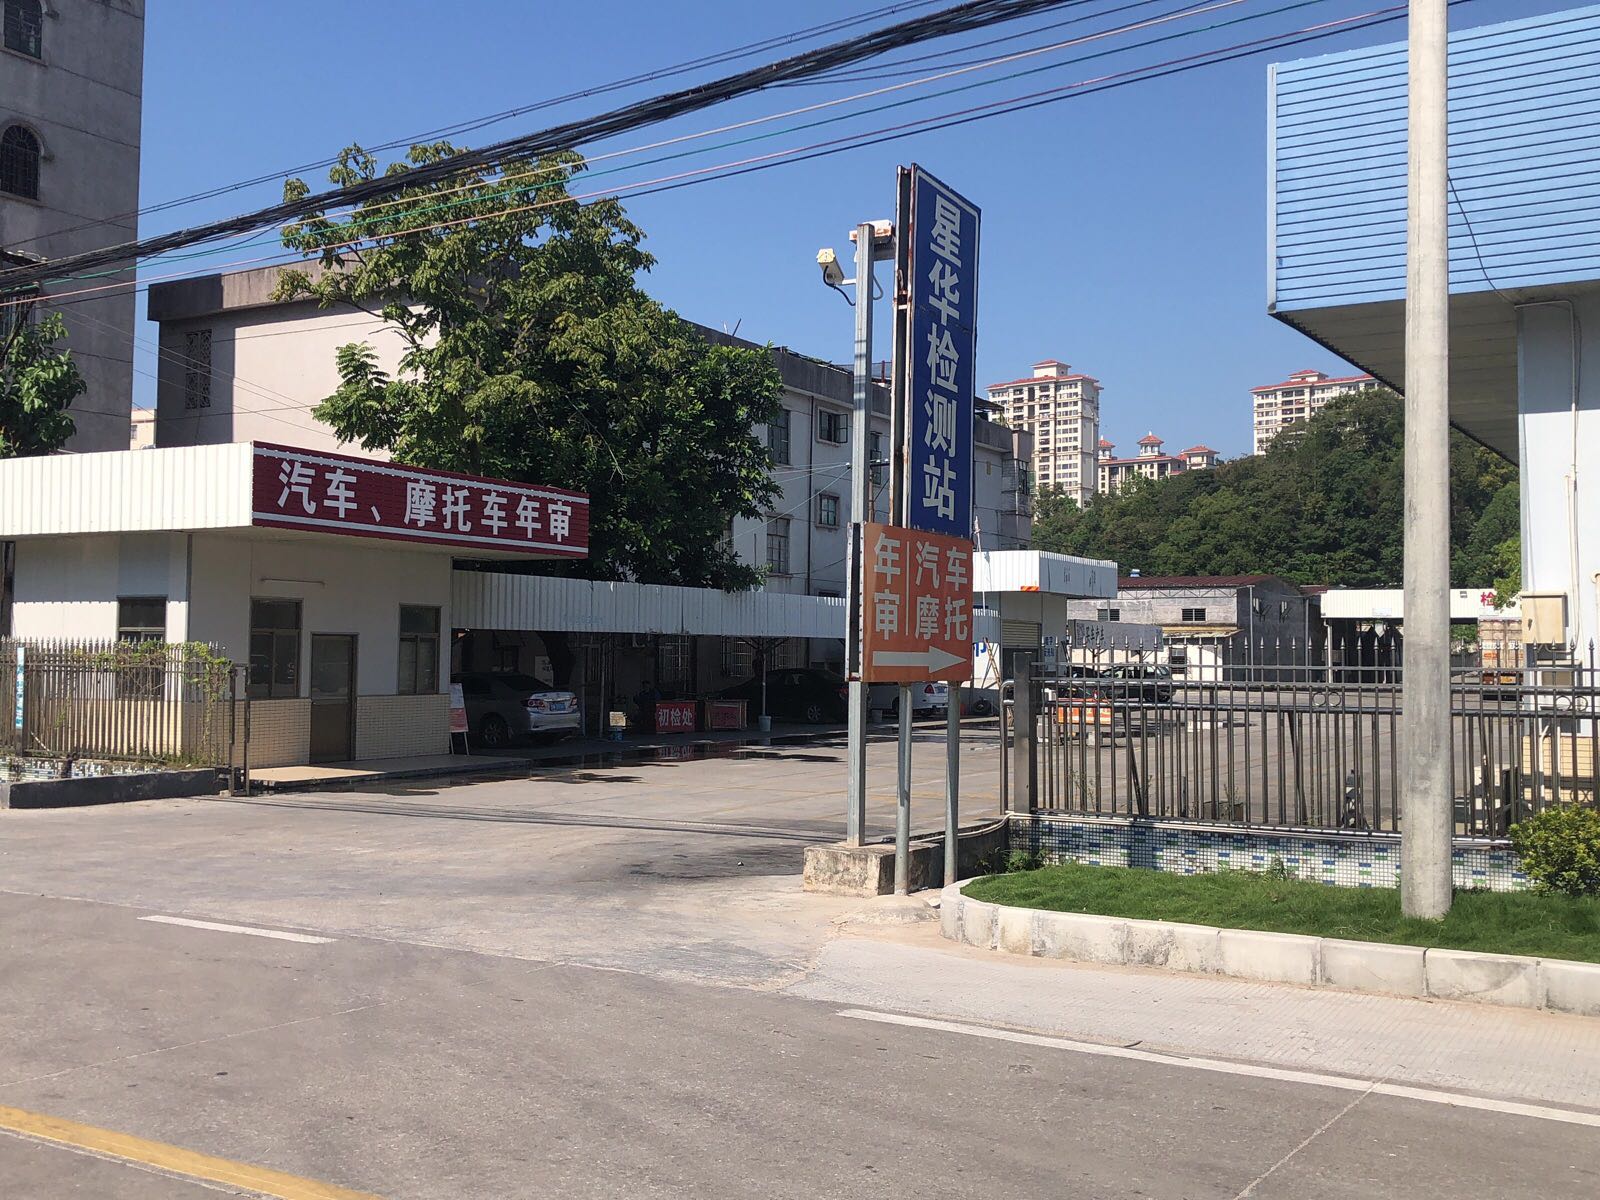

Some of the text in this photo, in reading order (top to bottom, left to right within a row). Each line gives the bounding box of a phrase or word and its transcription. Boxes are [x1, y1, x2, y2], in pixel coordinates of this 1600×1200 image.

[922, 193, 963, 522] 星华检测站
[277, 461, 573, 543] 汽车、摩托车年审
[873, 532, 901, 641] 年审
[914, 540, 968, 593] 汽车
[914, 596, 968, 641] 摩托
[658, 708, 693, 727] 初检处
